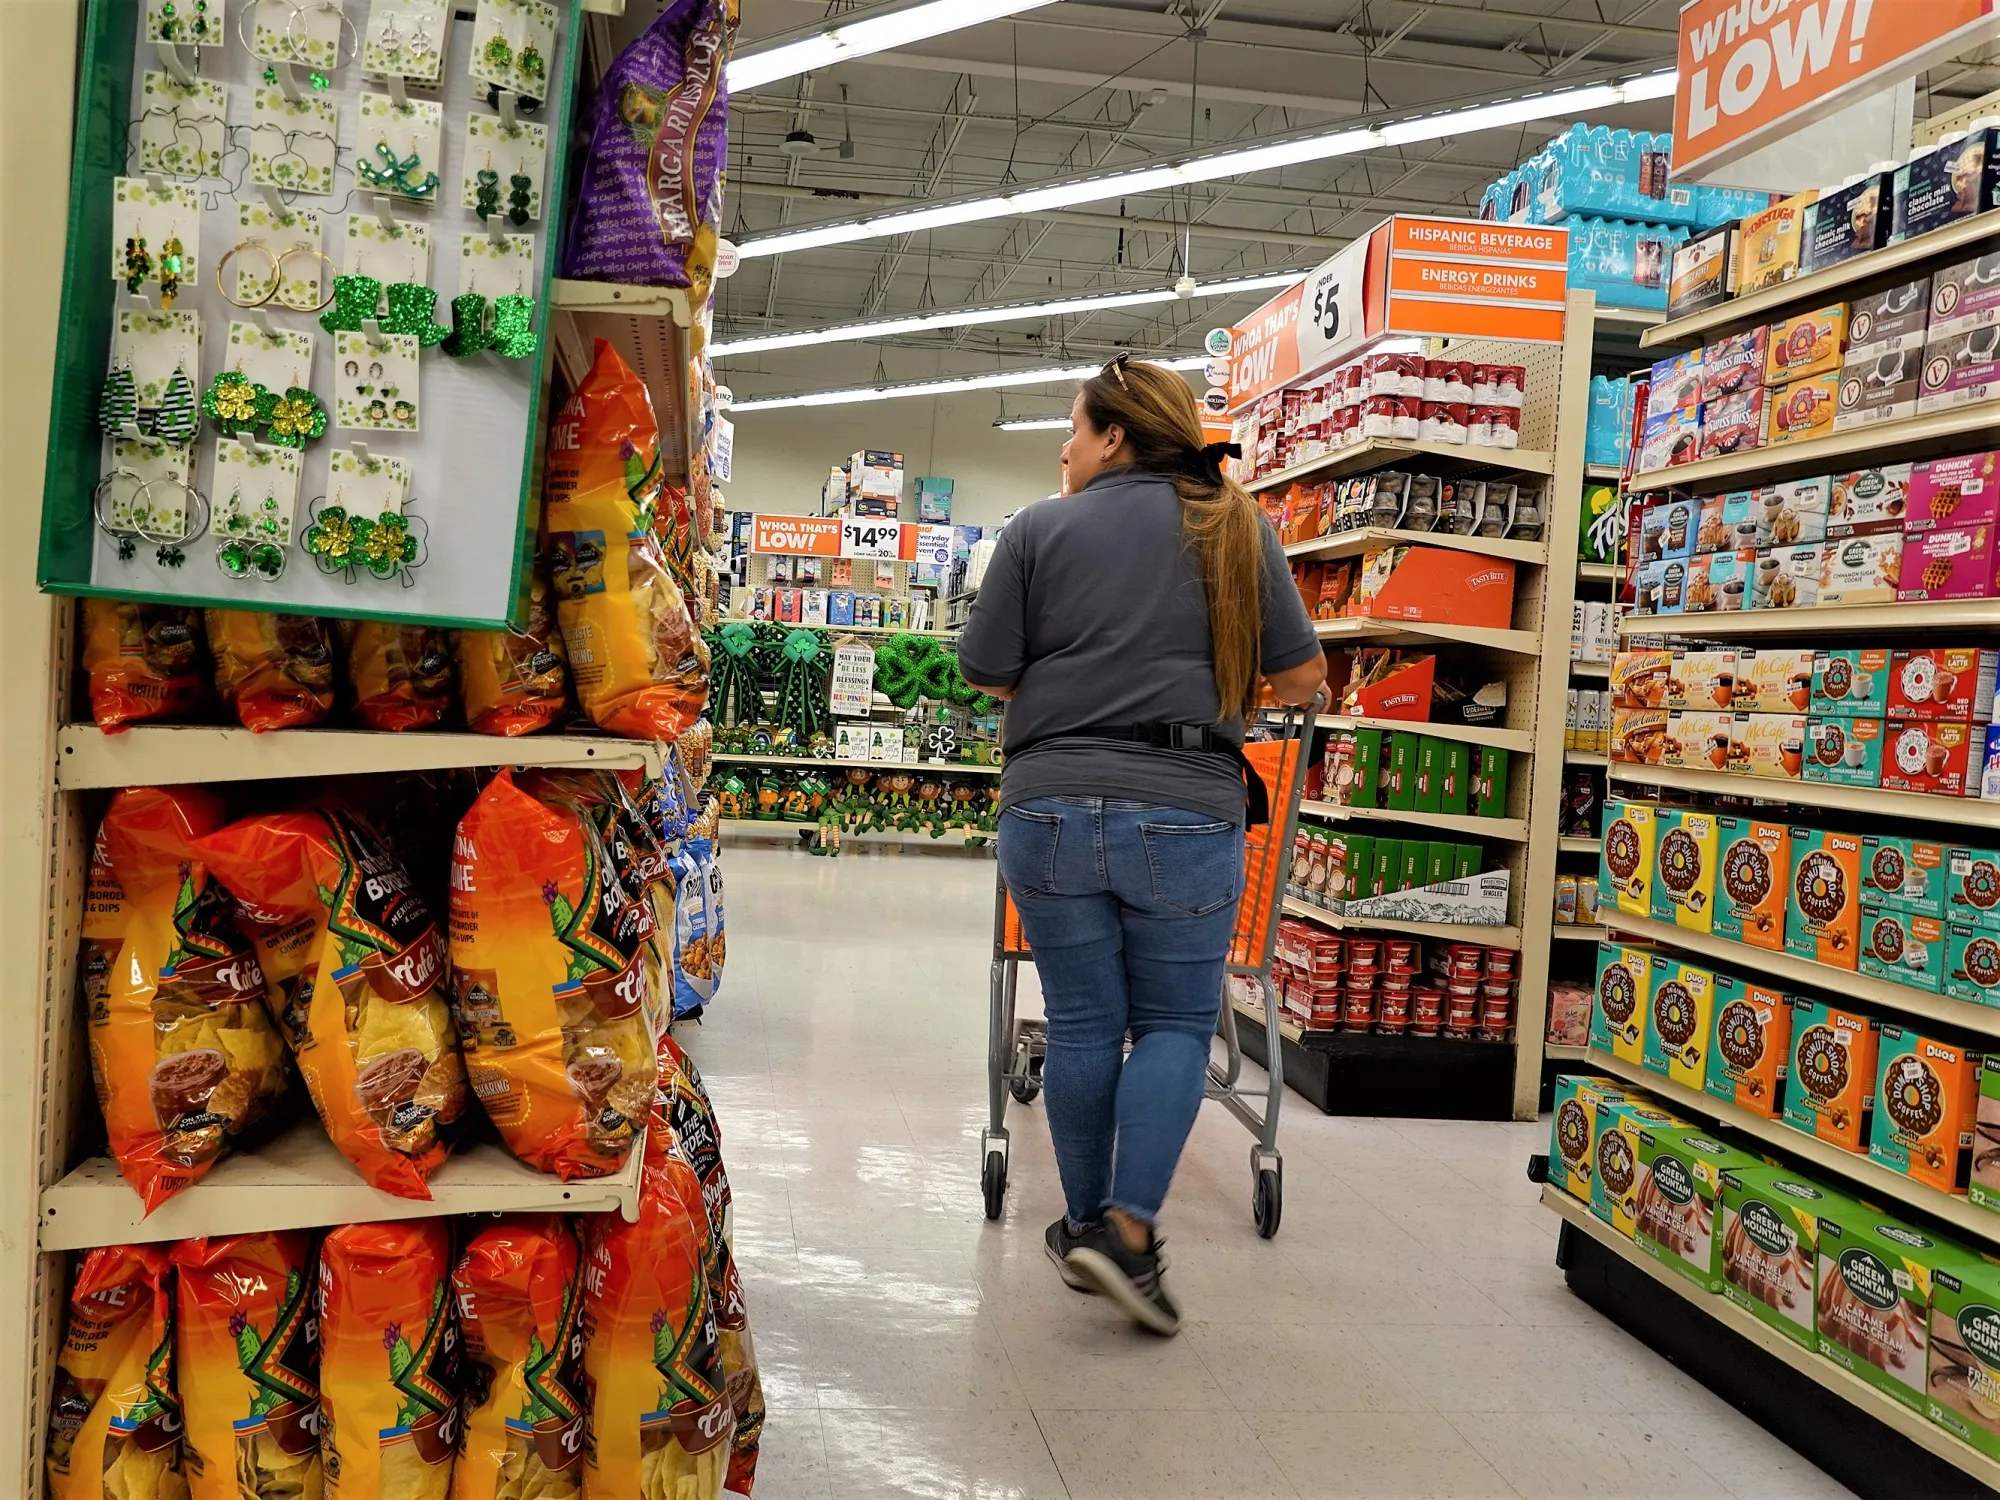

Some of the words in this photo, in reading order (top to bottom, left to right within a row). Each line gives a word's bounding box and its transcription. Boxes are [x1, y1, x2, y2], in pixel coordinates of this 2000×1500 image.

[542, 6, 553, 16] $6
[1690, 0, 1801, 63] WHO
[1688, 0, 1872, 140] LOW!
[212, 85, 223, 94] $6
[322, 101, 333, 110] $6
[427, 105, 438, 114] $6
[1908, 192, 1933, 208] classic
[1933, 184, 1951, 196] milk
[1907, 195, 1945, 216] chocolate
[1408, 227, 1476, 245] HISPANIC
[1480, 233, 1553, 251] BEVERAGE
[1814, 233, 1846, 251] chocolate
[1449, 243, 1474, 254] BEBIDAS
[1475, 245, 1512, 256] HISPANAS
[1421, 268, 1479, 285] ENERGY
[1482, 273, 1537, 289] DRINKS
[1439, 283, 1465, 293] BEBIDAS
[1466, 285, 1518, 296] ENERGIZANTES
[1314, 283, 1340, 340] $5
[1233, 325, 1262, 358] WHOA
[1265, 299, 1300, 337] THAT'S
[1231, 336, 1278, 397] LOW!
[715, 392, 731, 402] EINZ
[1935, 459, 1973, 473] DUNKIN'
[1857, 502, 1874, 510] MAPLE
[1857, 507, 1874, 515] PECAN
[758, 521, 797, 532] WHOA
[799, 523, 838, 535] THAT'S
[1826, 528, 1834, 536] 12
[1905, 521, 1913, 531] 10
[759, 531, 816, 552] LOW!
[878, 550, 889, 558] 20
[1471, 572, 1489, 586] TASTY
[1489, 570, 1505, 581] BITE
[1833, 572, 1859, 580] CINNAMON
[1844, 576, 1863, 584] COOKIE
[1898, 591, 1905, 600] 10
[1572, 605, 1582, 631] ZEST
[854, 654, 871, 663] YOUR
[1618, 662, 1641, 680] Apple
[1641, 654, 1664, 668] Cider
[1681, 657, 1718, 678] McCafé
[1752, 656, 1795, 679] McCafé
[836, 676, 870, 685] BLESSINGS
[833, 693, 869, 702] HAPPINESS
[1383, 696, 1401, 709] TASTY
[1401, 695, 1416, 704] BITE
[1618, 720, 1641, 738] Apple
[1640, 713, 1662, 725] Cider
[1677, 716, 1714, 736] McCafé
[1940, 733, 1961, 741] LATTE
[1736, 845, 1759, 857] ORIGINAL
[1731, 853, 1750, 879] DONUT
[1750, 856, 1761, 883] SHOP
[1483, 889, 1503, 897] SINGLES
[1666, 887, 1688, 898] Coconut
[1734, 880, 1757, 892] COFFEE
[88, 890, 126, 901] BORDER
[1807, 895, 1831, 907] COFFEE
[90, 903, 98, 913] &
[99, 903, 120, 914] DIPS
[1735, 901, 1753, 912] Nutty
[1713, 921, 1722, 931] 24
[1808, 916, 1827, 928] Nutty
[215, 958, 264, 993] Café
[396, 949, 436, 990] Café
[1888, 965, 1917, 974] CINNAMON
[1917, 971, 1937, 980] DULCE
[1732, 1006, 1754, 1020] ORIGINAL
[1660, 1038, 1682, 1053] Coconut
[1805, 1040, 1825, 1066] DONUT
[1825, 1043, 1839, 1077] SHOP
[1808, 1067, 1833, 1084] COFFEE
[474, 1079, 510, 1099] SHARING
[1809, 1090, 1828, 1104] Nutty
[1915, 1074, 1932, 1112] SHOP
[1784, 1108, 1793, 1119] 24
[680, 1114, 699, 1138] THE
[1871, 1144, 1882, 1155] 24
[699, 1153, 714, 1164] GRILL
[1660, 1164, 1686, 1183] GREEN
[702, 1173, 729, 1211] Style
[1603, 1185, 1624, 1201] Coconut
[1654, 1172, 1692, 1198] MOUNTAIN
[1971, 1188, 1986, 1205] 32
[1655, 1200, 1686, 1224] CARAMEL
[1646, 1205, 1673, 1227] VANILLA
[1673, 1219, 1696, 1238] CREAM
[1750, 1210, 1780, 1231] GREEN
[1743, 1216, 1788, 1248] MOUNTAIN
[1745, 1250, 1783, 1277] CARAMEL
[1735, 1253, 1766, 1279] VANILLA
[1765, 1271, 1795, 1293] CREAM
[1850, 1259, 1886, 1286] GREEN
[1842, 1265, 1895, 1302] MOUNTAIN
[102, 1320, 113, 1330] OF
[1845, 1301, 1890, 1334] CARAMEL
[70, 1327, 109, 1341] BORDER
[1832, 1304, 1870, 1335] VANILLA
[1869, 1325, 1904, 1354] CREAM
[75, 1341, 98, 1352] DIPS
[1819, 1339, 1831, 1355] 32
[1967, 1378, 2000, 1403] VANIL
[1928, 1403, 1943, 1419] 32
